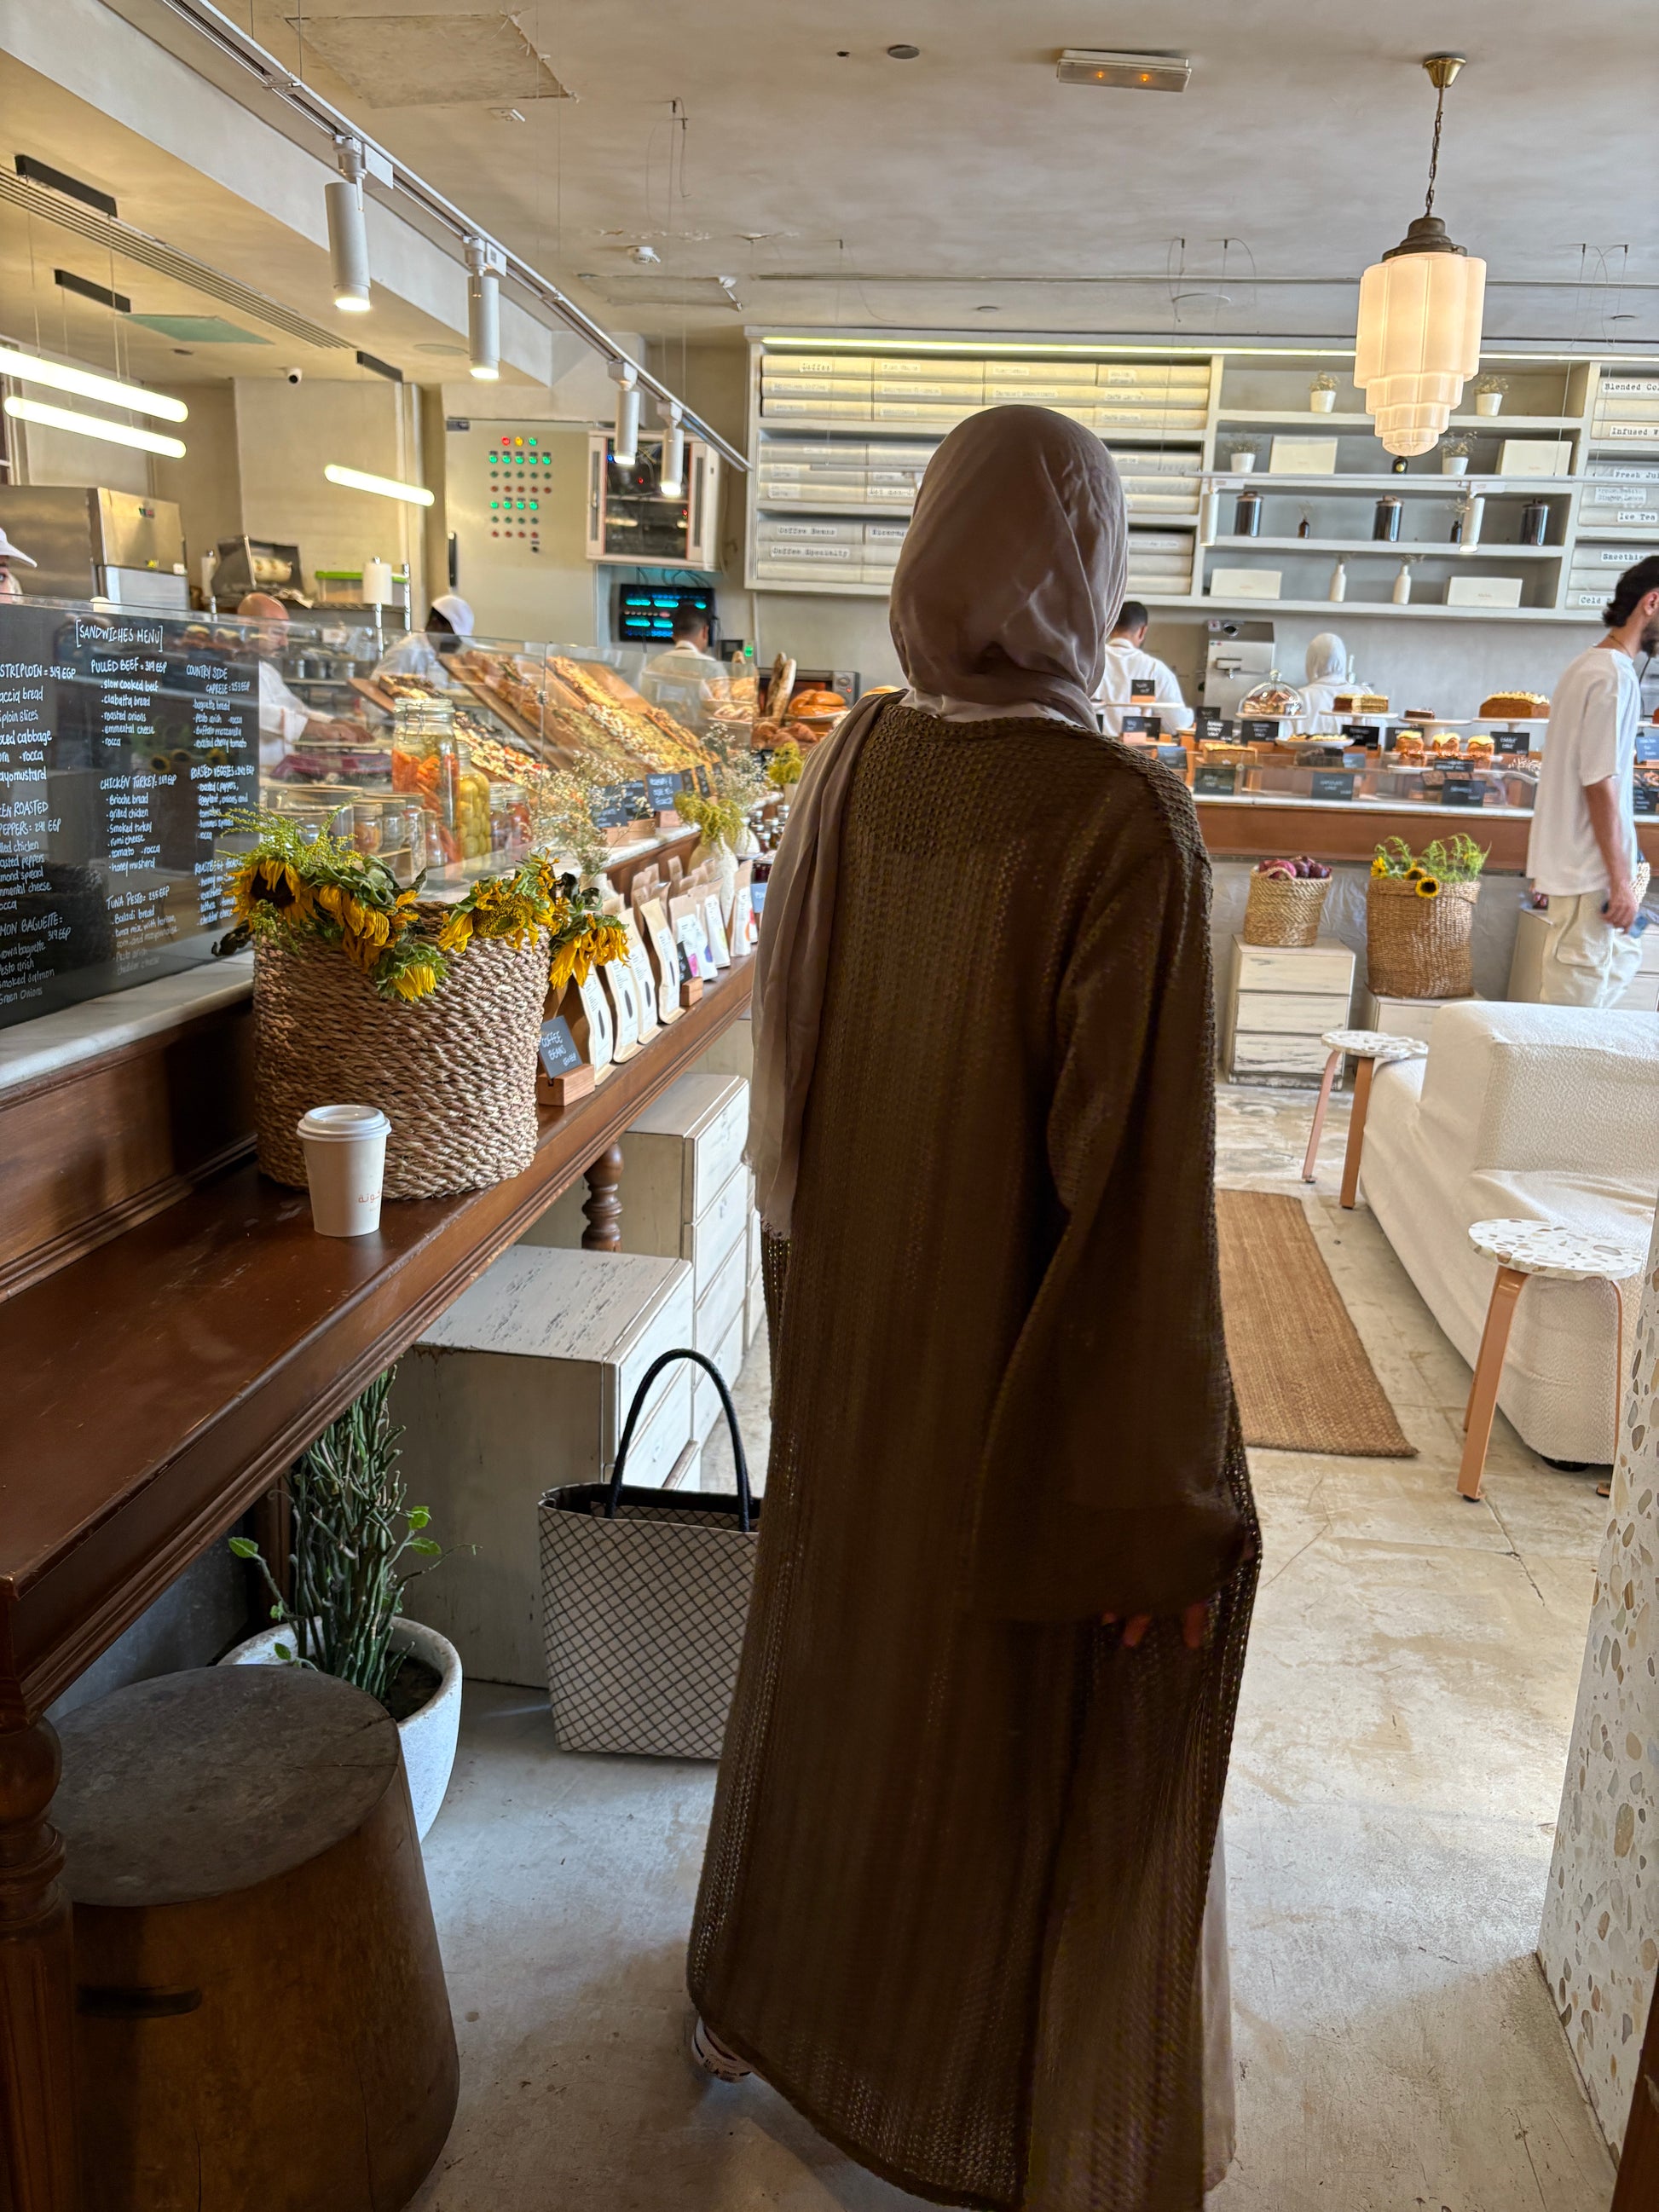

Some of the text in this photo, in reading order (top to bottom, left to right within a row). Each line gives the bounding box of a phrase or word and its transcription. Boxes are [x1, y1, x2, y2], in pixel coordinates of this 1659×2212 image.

[1646, 383, 1659, 391] Co
[1611, 427, 1648, 436] Infused
[1619, 512, 1656, 521] Ice Tea
[1581, 596, 1601, 604] Cold
[90, 659, 118, 673] PULLED
[120, 656, 139, 672] BEEF
[186, 664, 228, 680] COUNTRY SIDE
[22, 685, 43, 701] bread
[103, 679, 159, 693] slow cooked beef
[20, 708, 39, 722] slices
[17, 727, 53, 747] cabbage
[190, 763, 213, 781] ROASTED
[100, 775, 131, 790] CHICKEN
[14, 800, 49, 817] ROASTED
[13, 840, 40, 853] chicken
[21, 854, 45, 871] peppers
[27, 880, 53, 892] cheese
[106, 893, 124, 910] TUNA
